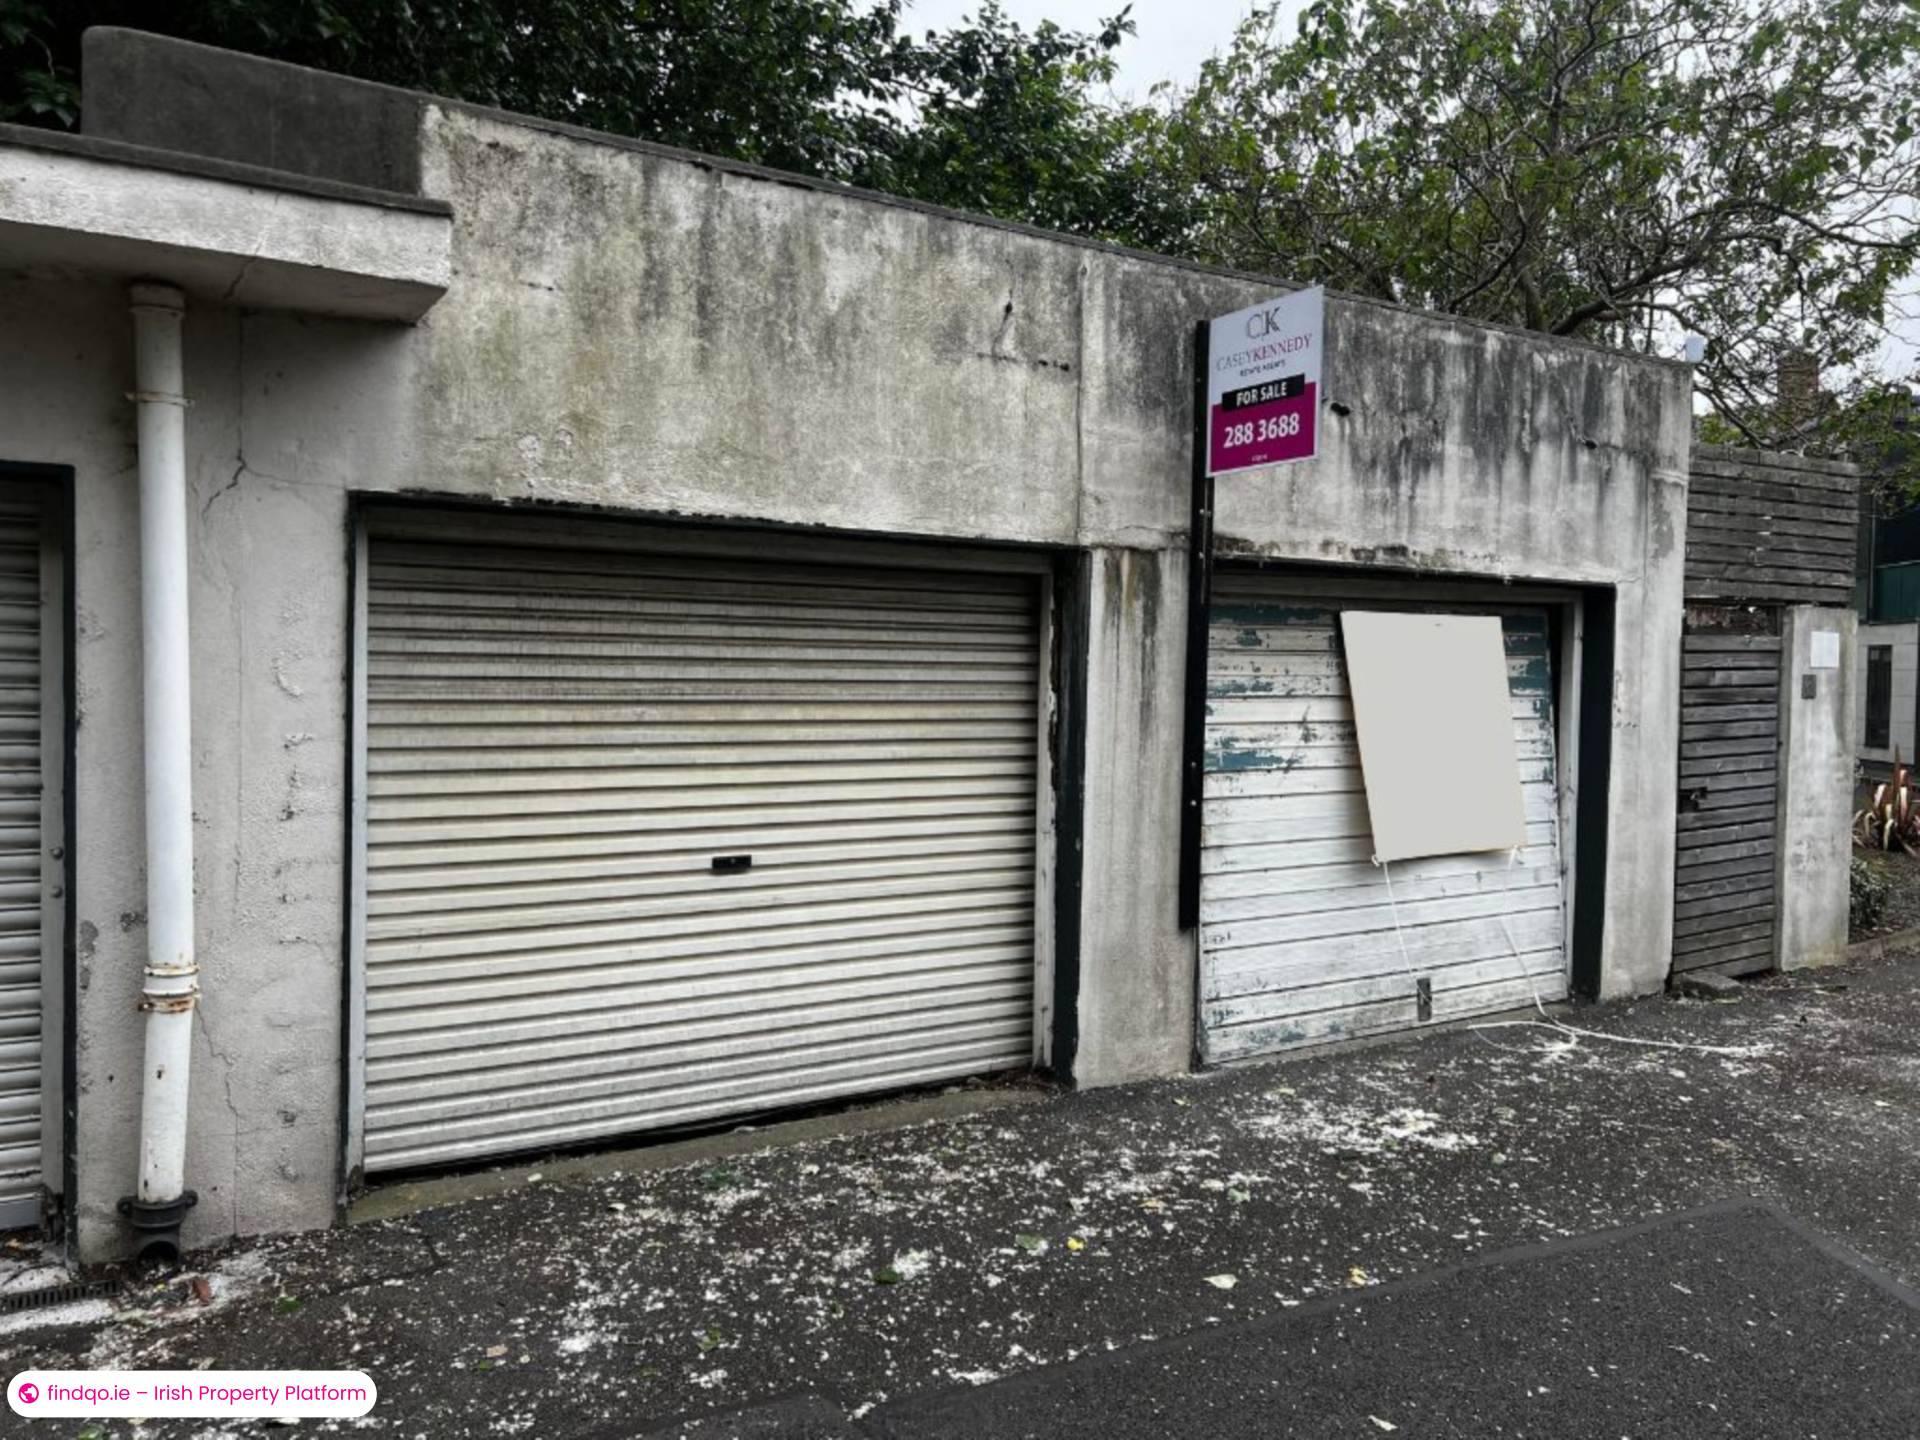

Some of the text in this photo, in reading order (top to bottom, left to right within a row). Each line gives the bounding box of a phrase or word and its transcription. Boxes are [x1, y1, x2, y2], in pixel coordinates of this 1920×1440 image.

[1236, 382, 1287, 407] FOR SALE
[1223, 412, 1300, 449] 288 3688
